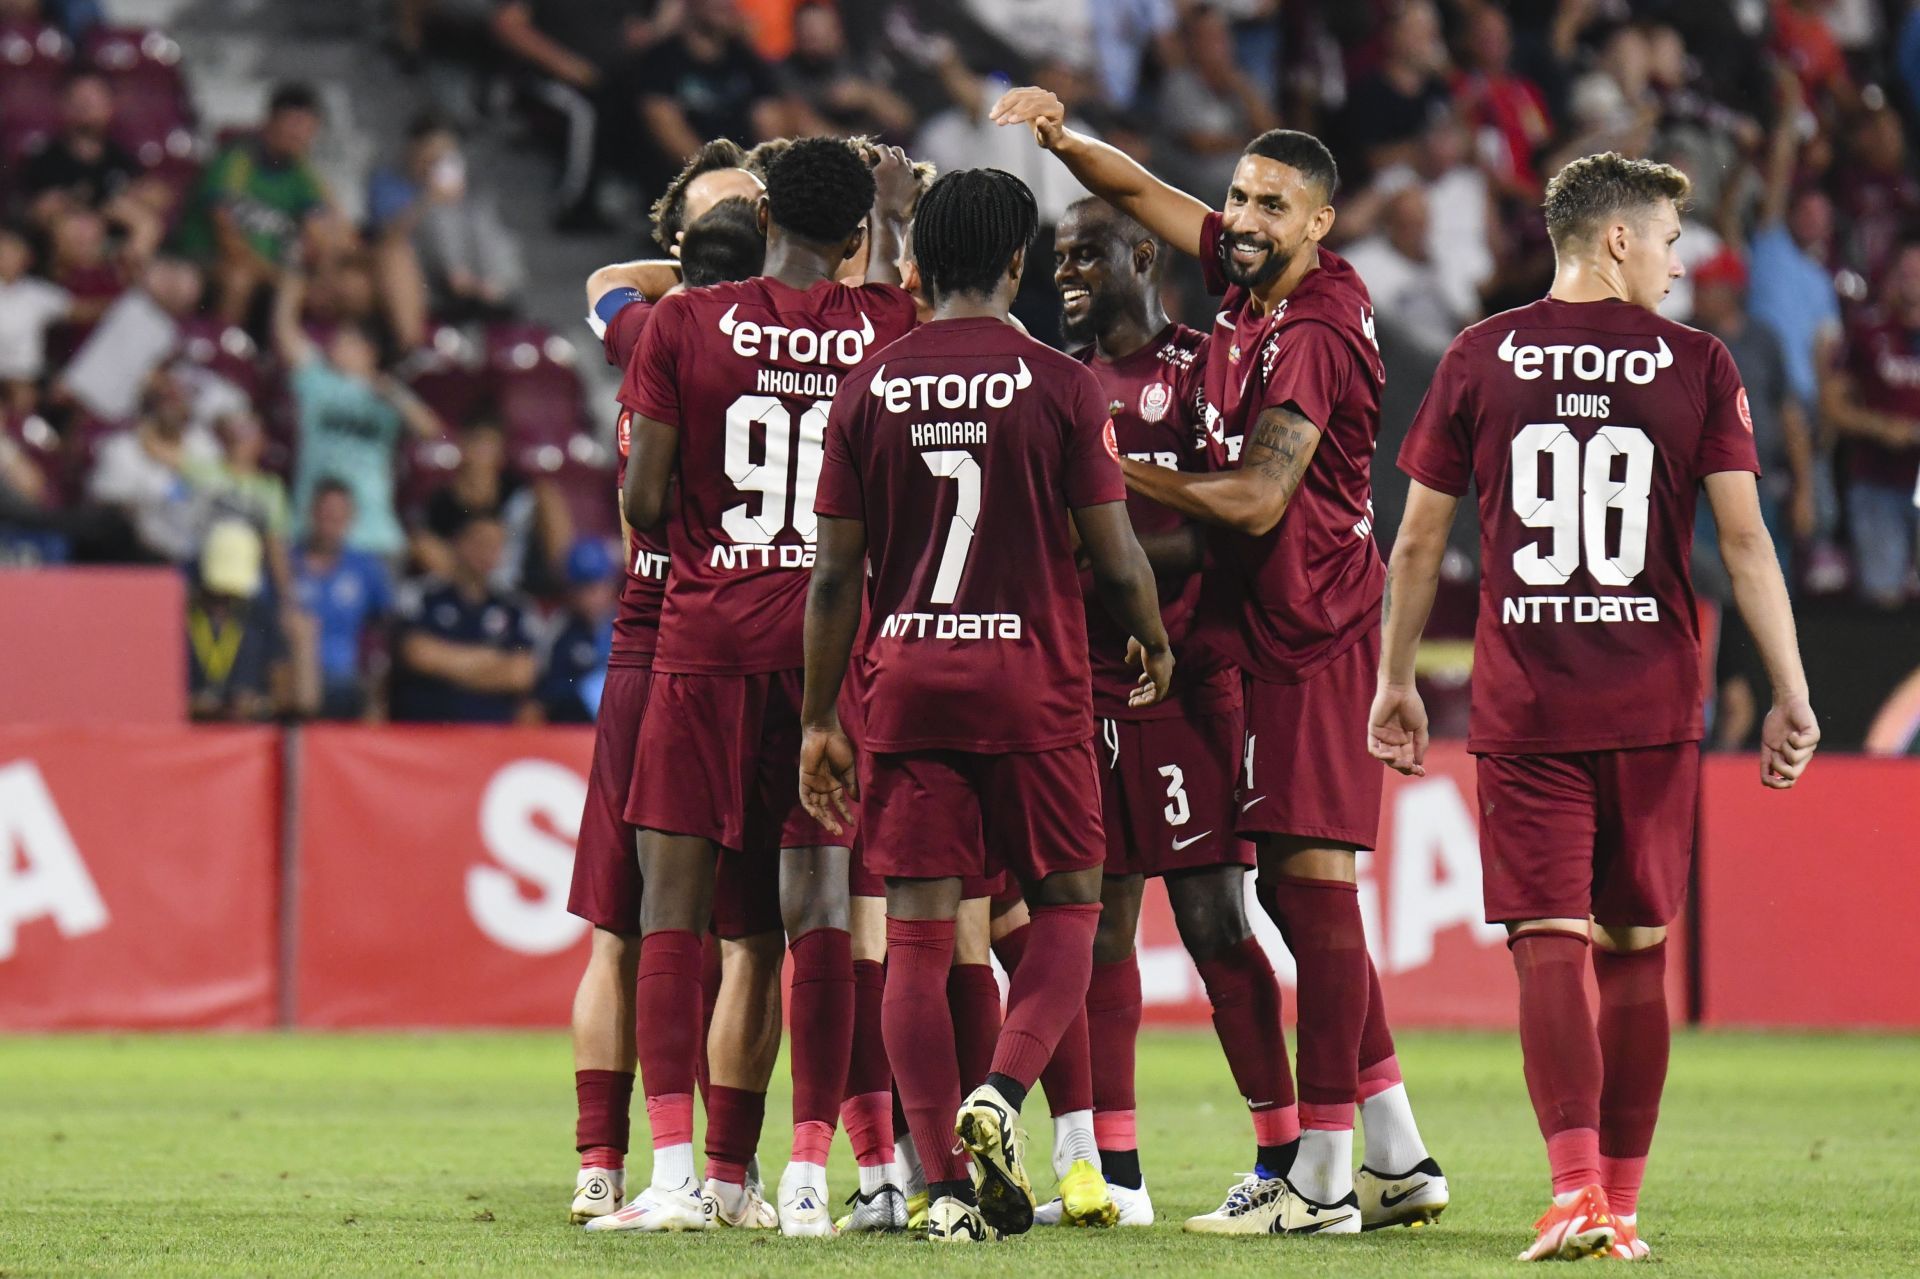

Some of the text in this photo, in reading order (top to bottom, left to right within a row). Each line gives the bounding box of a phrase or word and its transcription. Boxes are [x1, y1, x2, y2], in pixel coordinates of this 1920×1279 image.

[756, 369, 837, 397] NKOLOLO
[1556, 393, 1611, 419] LOUIS
[911, 421, 987, 446] KAMARA
[1511, 423, 1655, 587] 98
[920, 450, 982, 604] 7
[710, 543, 776, 569] NTT
[1502, 596, 1570, 625] NTT
[880, 612, 935, 638] NTT
[1157, 764, 1191, 826] 3
